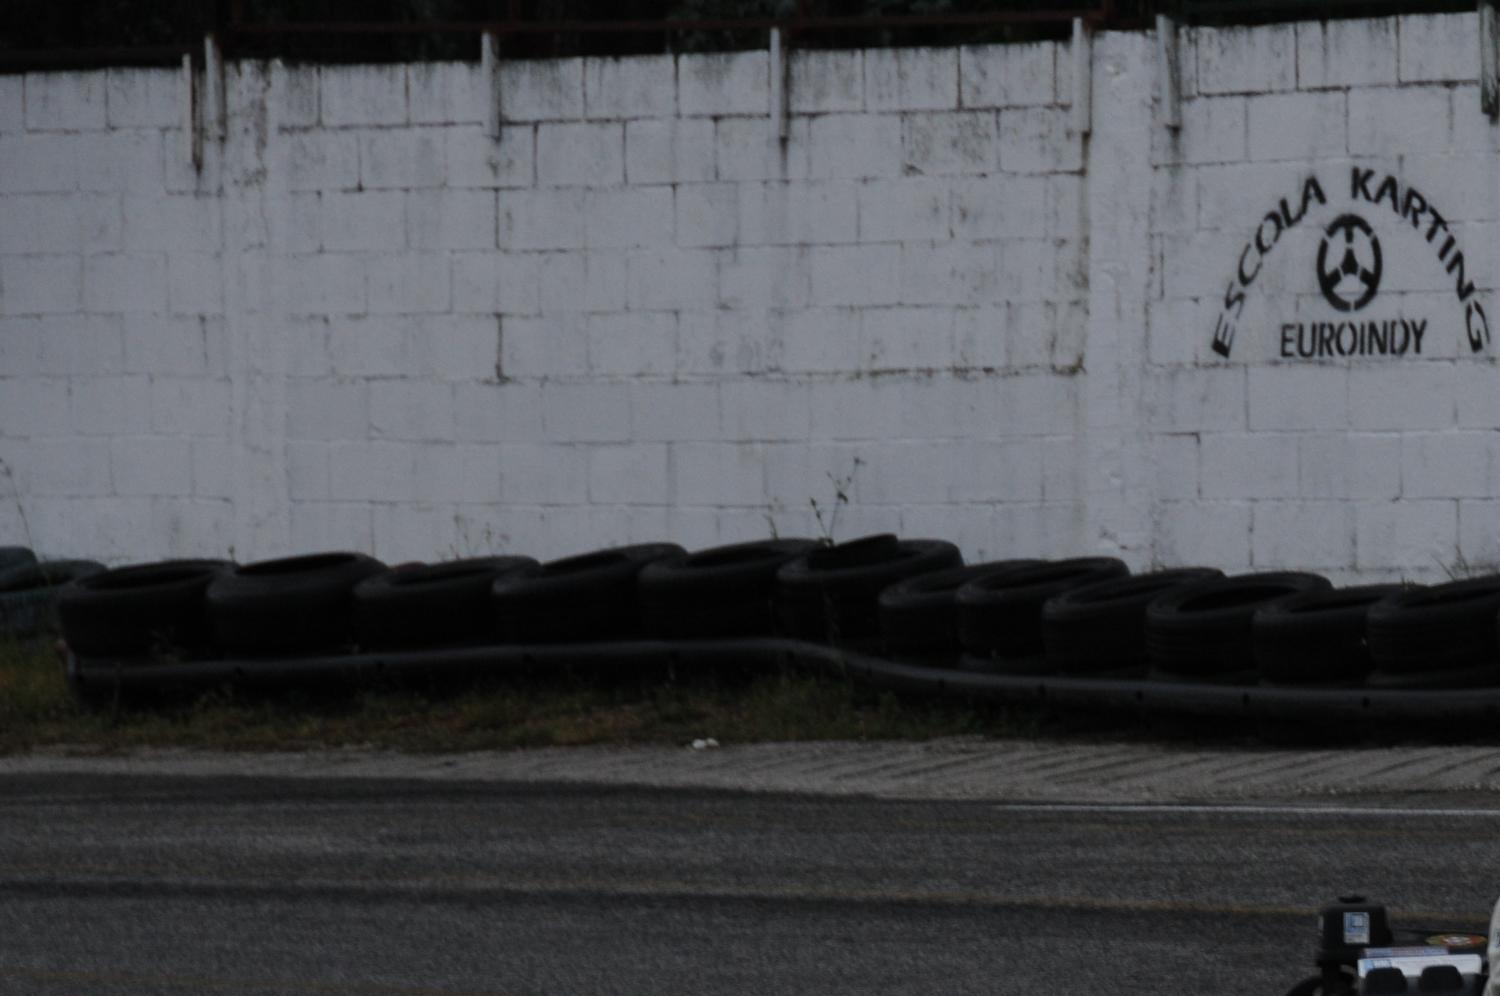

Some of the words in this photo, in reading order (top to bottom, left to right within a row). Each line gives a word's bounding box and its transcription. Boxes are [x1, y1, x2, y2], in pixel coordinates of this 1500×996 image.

[1211, 175, 1327, 359] ESCOLA
[1352, 165, 1491, 354] KARTING
[1280, 318, 1428, 358] EUROINDY
